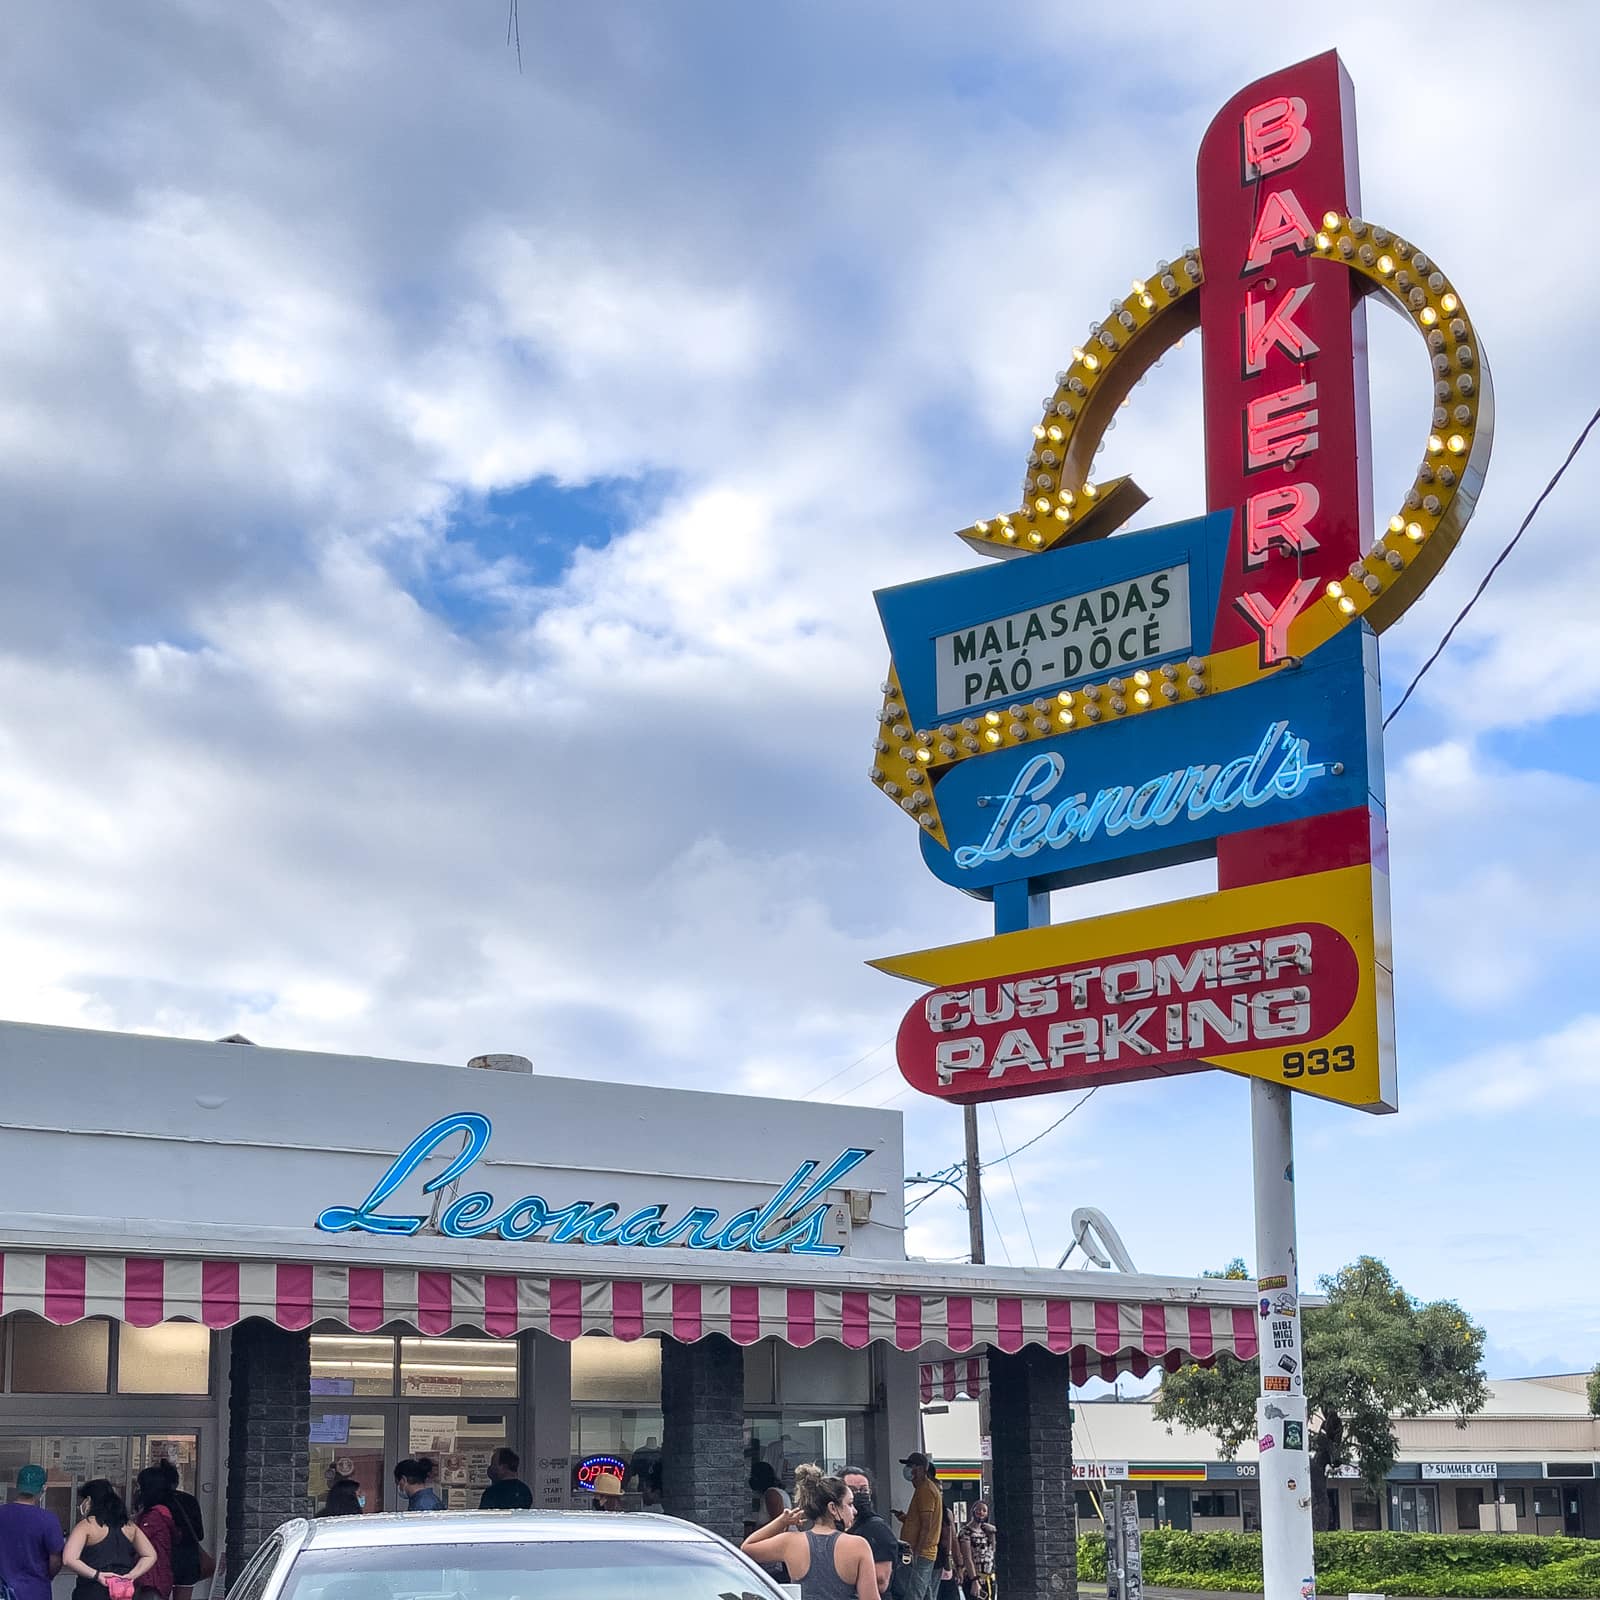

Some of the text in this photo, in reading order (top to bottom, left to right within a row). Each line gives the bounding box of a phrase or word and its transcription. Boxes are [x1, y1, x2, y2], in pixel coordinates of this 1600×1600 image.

[1236, 97, 1321, 668] BAKERY
[953, 574, 1171, 666] MALASADAS
[954, 720, 1326, 869] Leonard's
[926, 932, 1313, 1033] CUSTOMER
[936, 985, 1311, 1086] PARKING
[1283, 1046, 1355, 1078] 933
[317, 1112, 872, 1255] Leonard's
[578, 1466, 625, 1481] OPEN
[1236, 1465, 1256, 1476] 909
[1436, 1464, 1495, 1473] SUMMER CAFE
